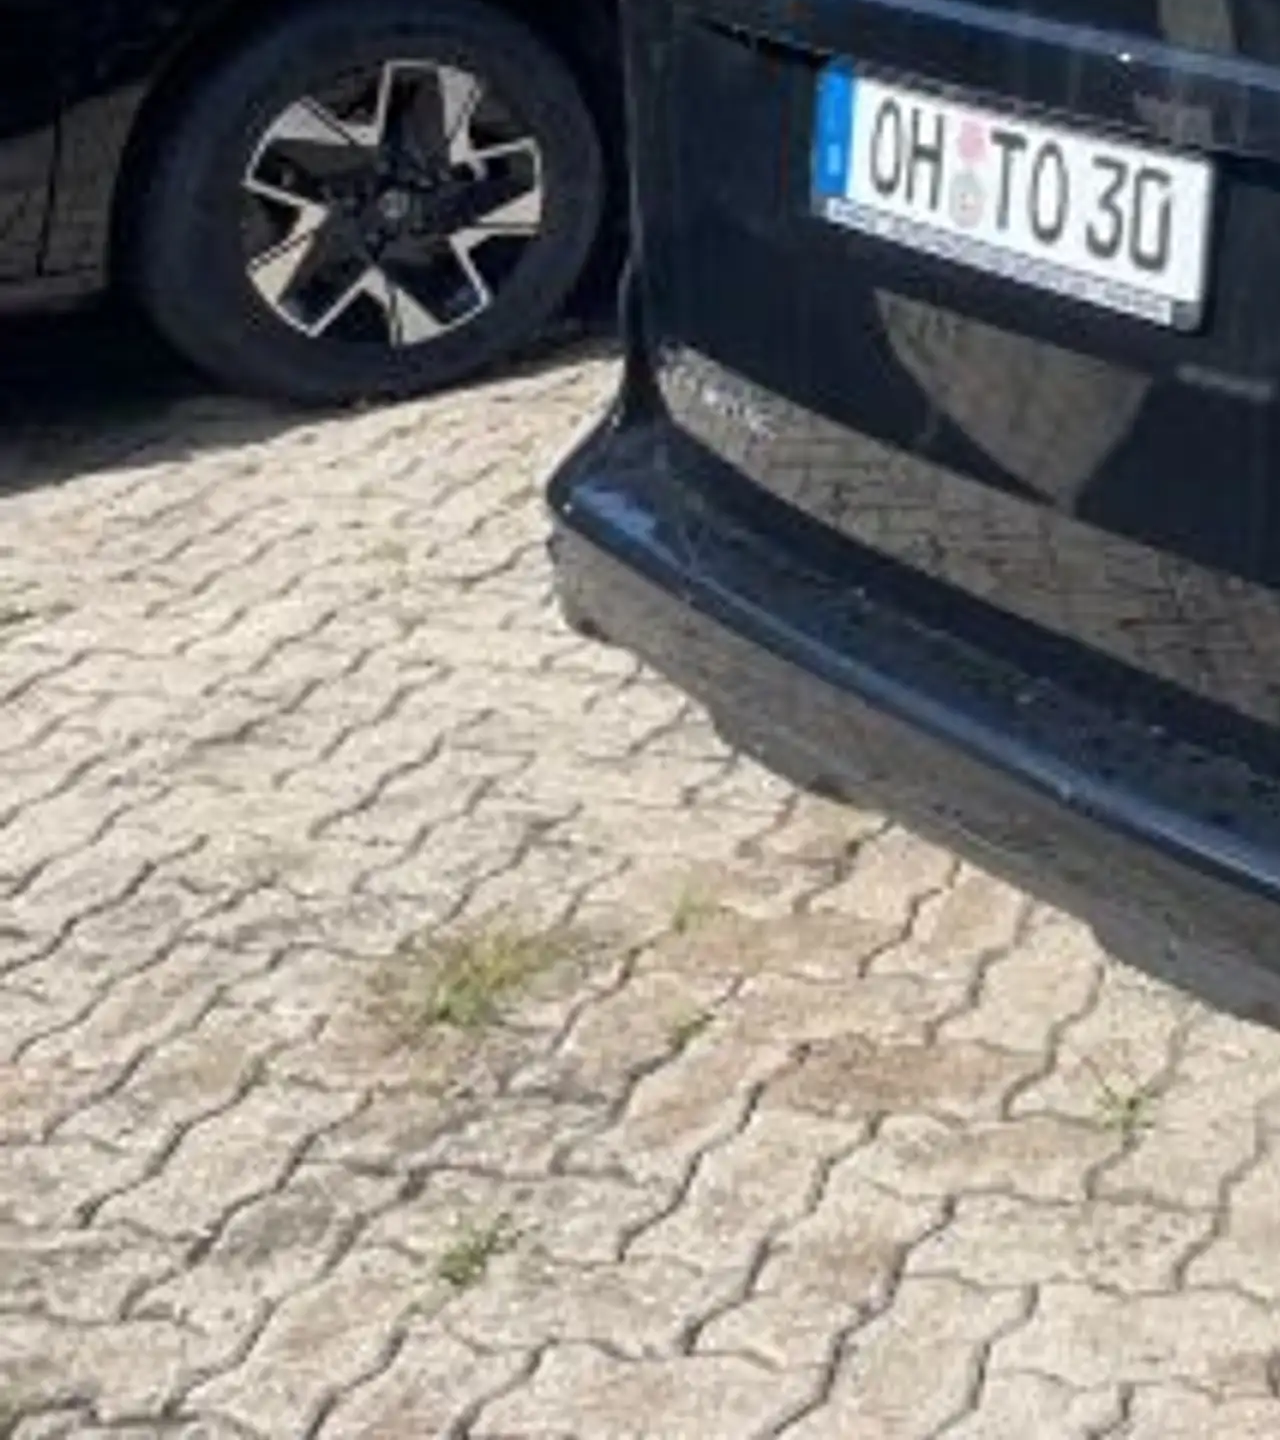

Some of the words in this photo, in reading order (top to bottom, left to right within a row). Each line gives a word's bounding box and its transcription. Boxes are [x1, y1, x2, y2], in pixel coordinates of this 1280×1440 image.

[869, 96, 945, 211] OH
[990, 130, 1070, 245] TO
[1085, 157, 1173, 270] 30
